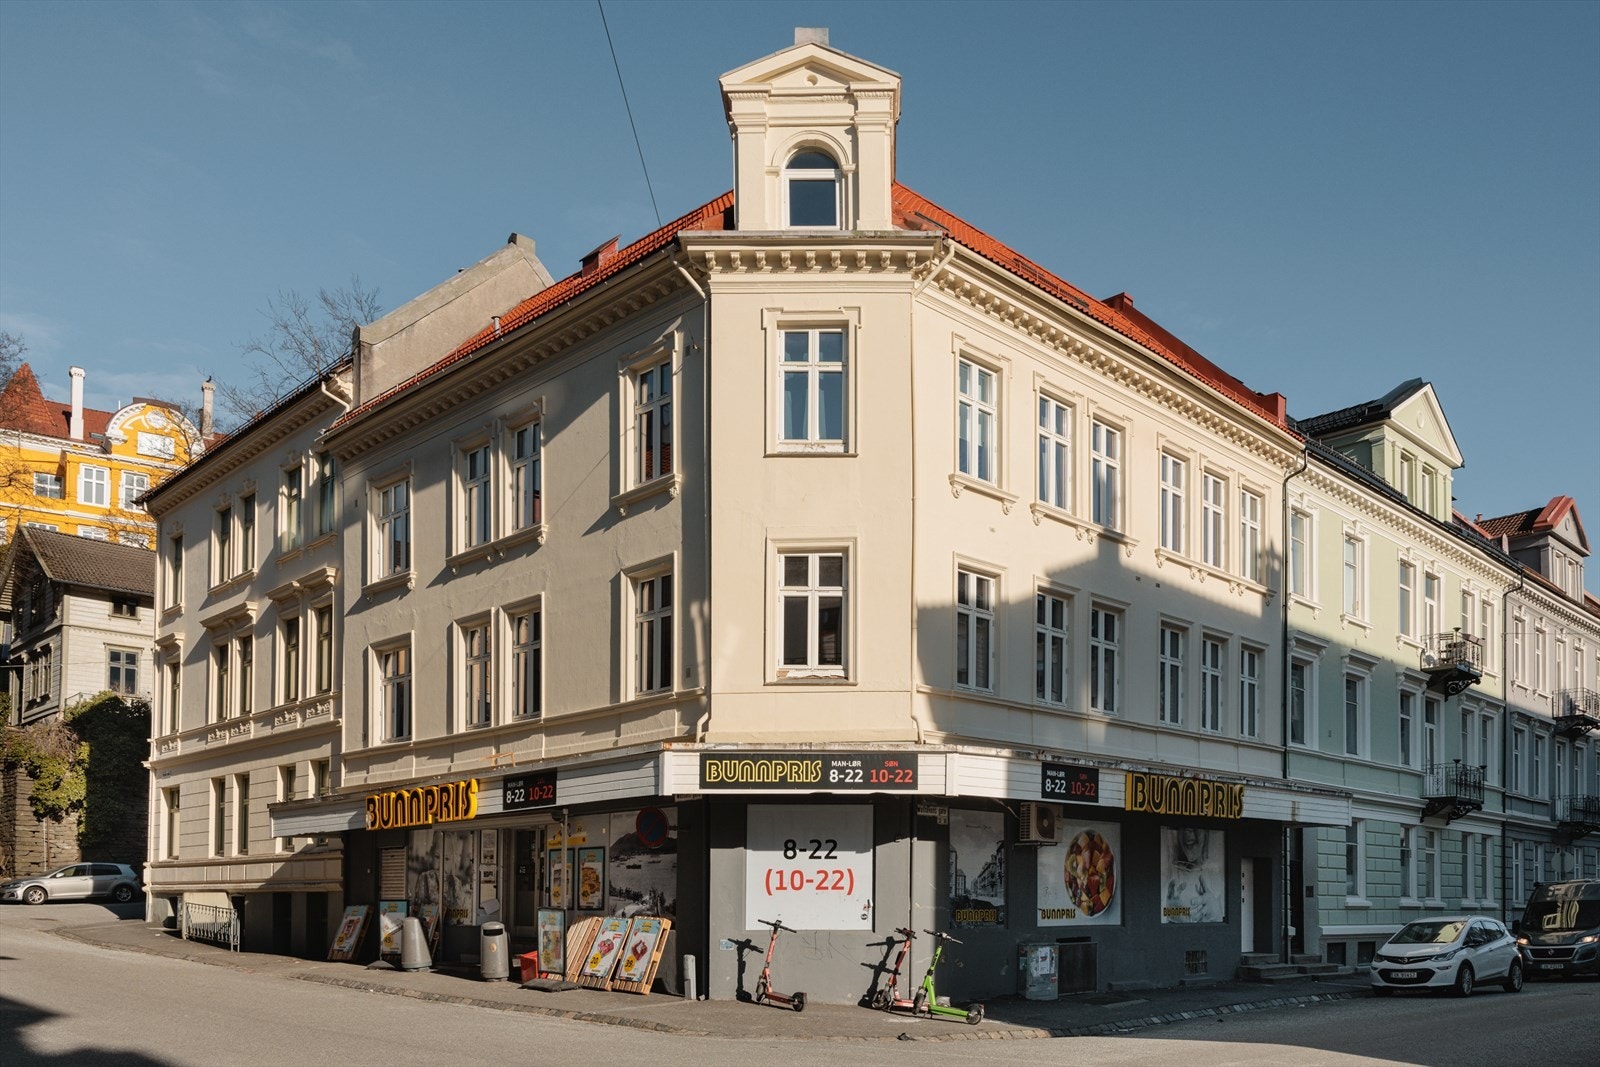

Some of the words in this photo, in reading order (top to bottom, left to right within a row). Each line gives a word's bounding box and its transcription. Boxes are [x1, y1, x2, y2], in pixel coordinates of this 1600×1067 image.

[706, 760, 822, 783] BUNNPRIS
[831, 760, 862, 768] MAN-LØR
[884, 760, 899, 768] SØN
[829, 769, 864, 783] 8-22
[870, 769, 914, 783] 10-22
[506, 788, 525, 804] 8-22
[528, 784, 554, 801] 10-22
[1045, 778, 1067, 794] 8-22
[1071, 780, 1096, 797] 10-22
[1128, 773, 1245, 819] BUNNPRIS
[366, 778, 480, 831] BUNNPRIS
[783, 838, 838, 860] 8-22
[764, 868, 855, 896] (10-22)
[955, 909, 997, 923] BUNNPRIS
[1041, 907, 1077, 920] BUNNPRIS
[1162, 907, 1191, 917] BUNNPRIS
